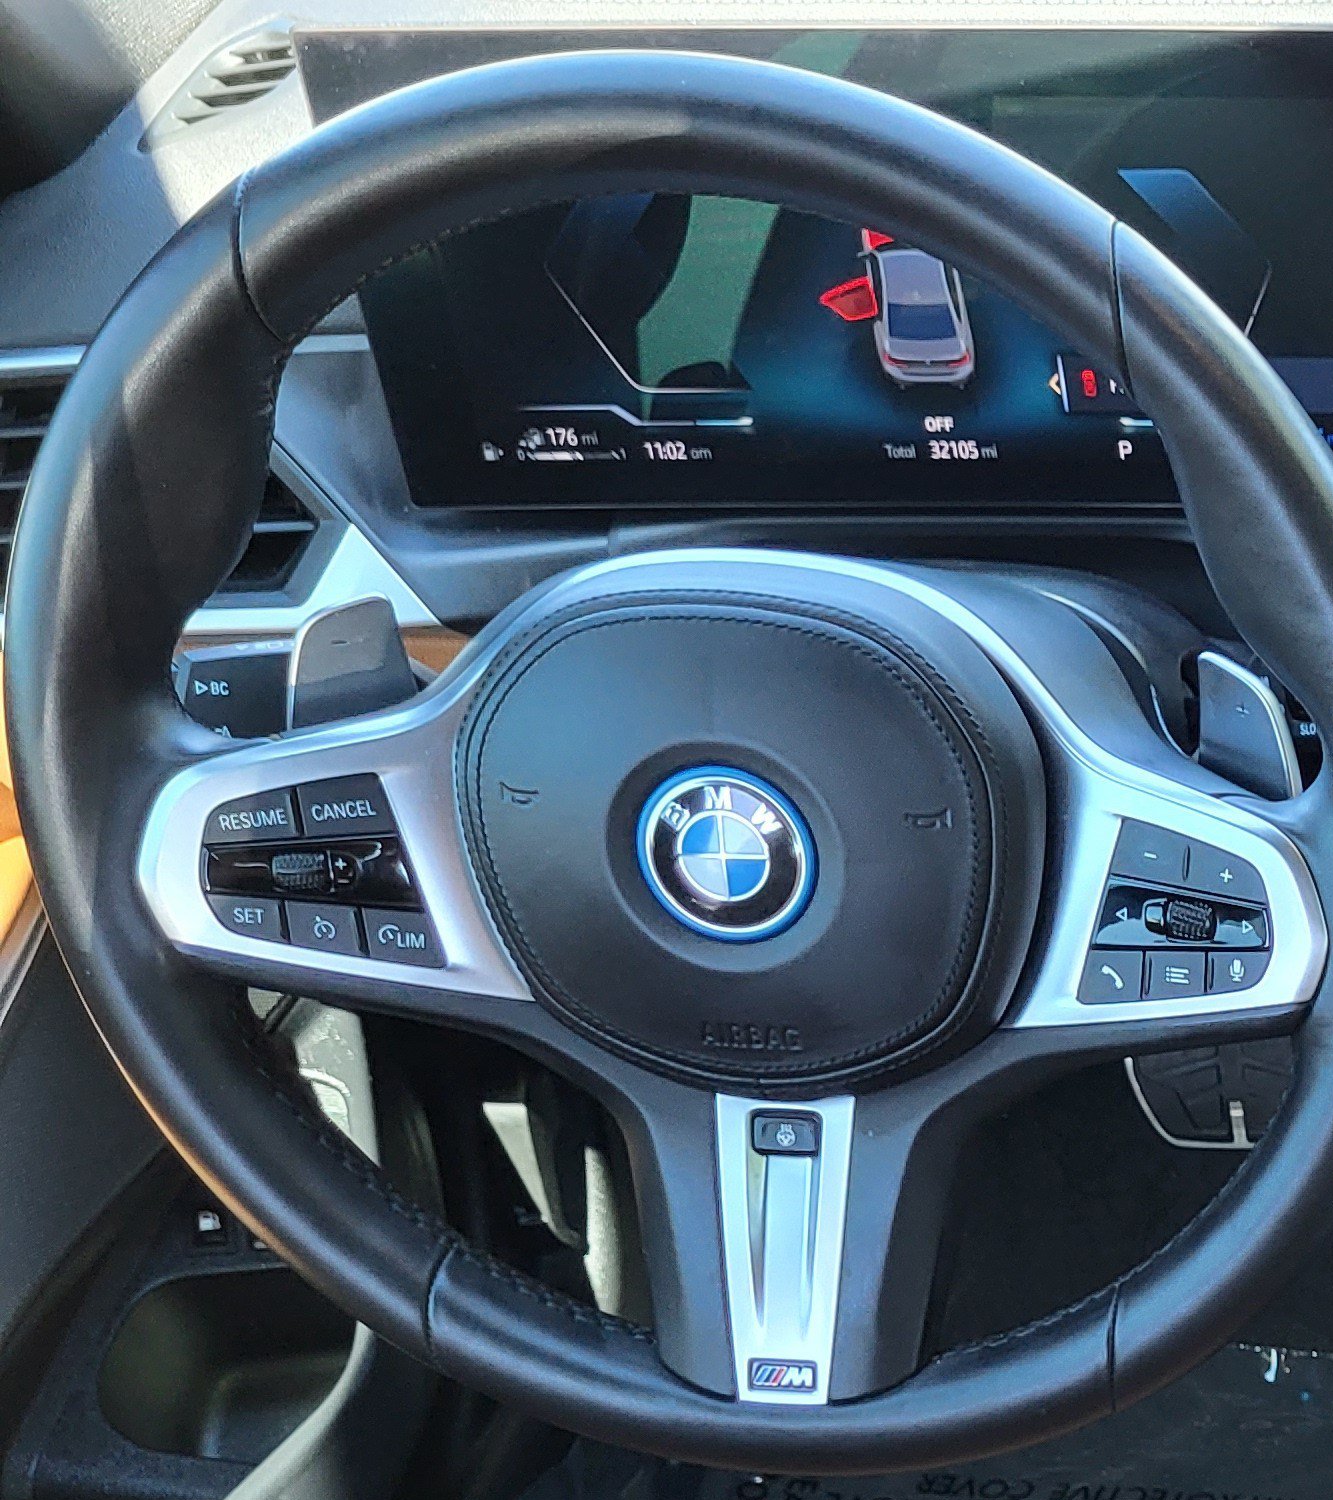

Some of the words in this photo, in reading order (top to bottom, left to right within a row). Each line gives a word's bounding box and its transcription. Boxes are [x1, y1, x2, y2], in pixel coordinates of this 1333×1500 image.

[924, 415, 954, 433] OFF
[546, 428, 578, 446] 176
[643, 441, 689, 461] 11:02
[883, 442, 916, 459] Total
[928, 439, 979, 460] 32105
[980, 443, 998, 459] mi
[1117, 440, 1133, 461] P
[210, 681, 230, 696] BC
[218, 808, 288, 832] RESUME
[311, 799, 377, 822] CANCEL
[662, 785, 783, 835] BMW
[233, 907, 264, 925] SET
[397, 932, 426, 950] LIM
[701, 1022, 803, 1050] AIRBAG
